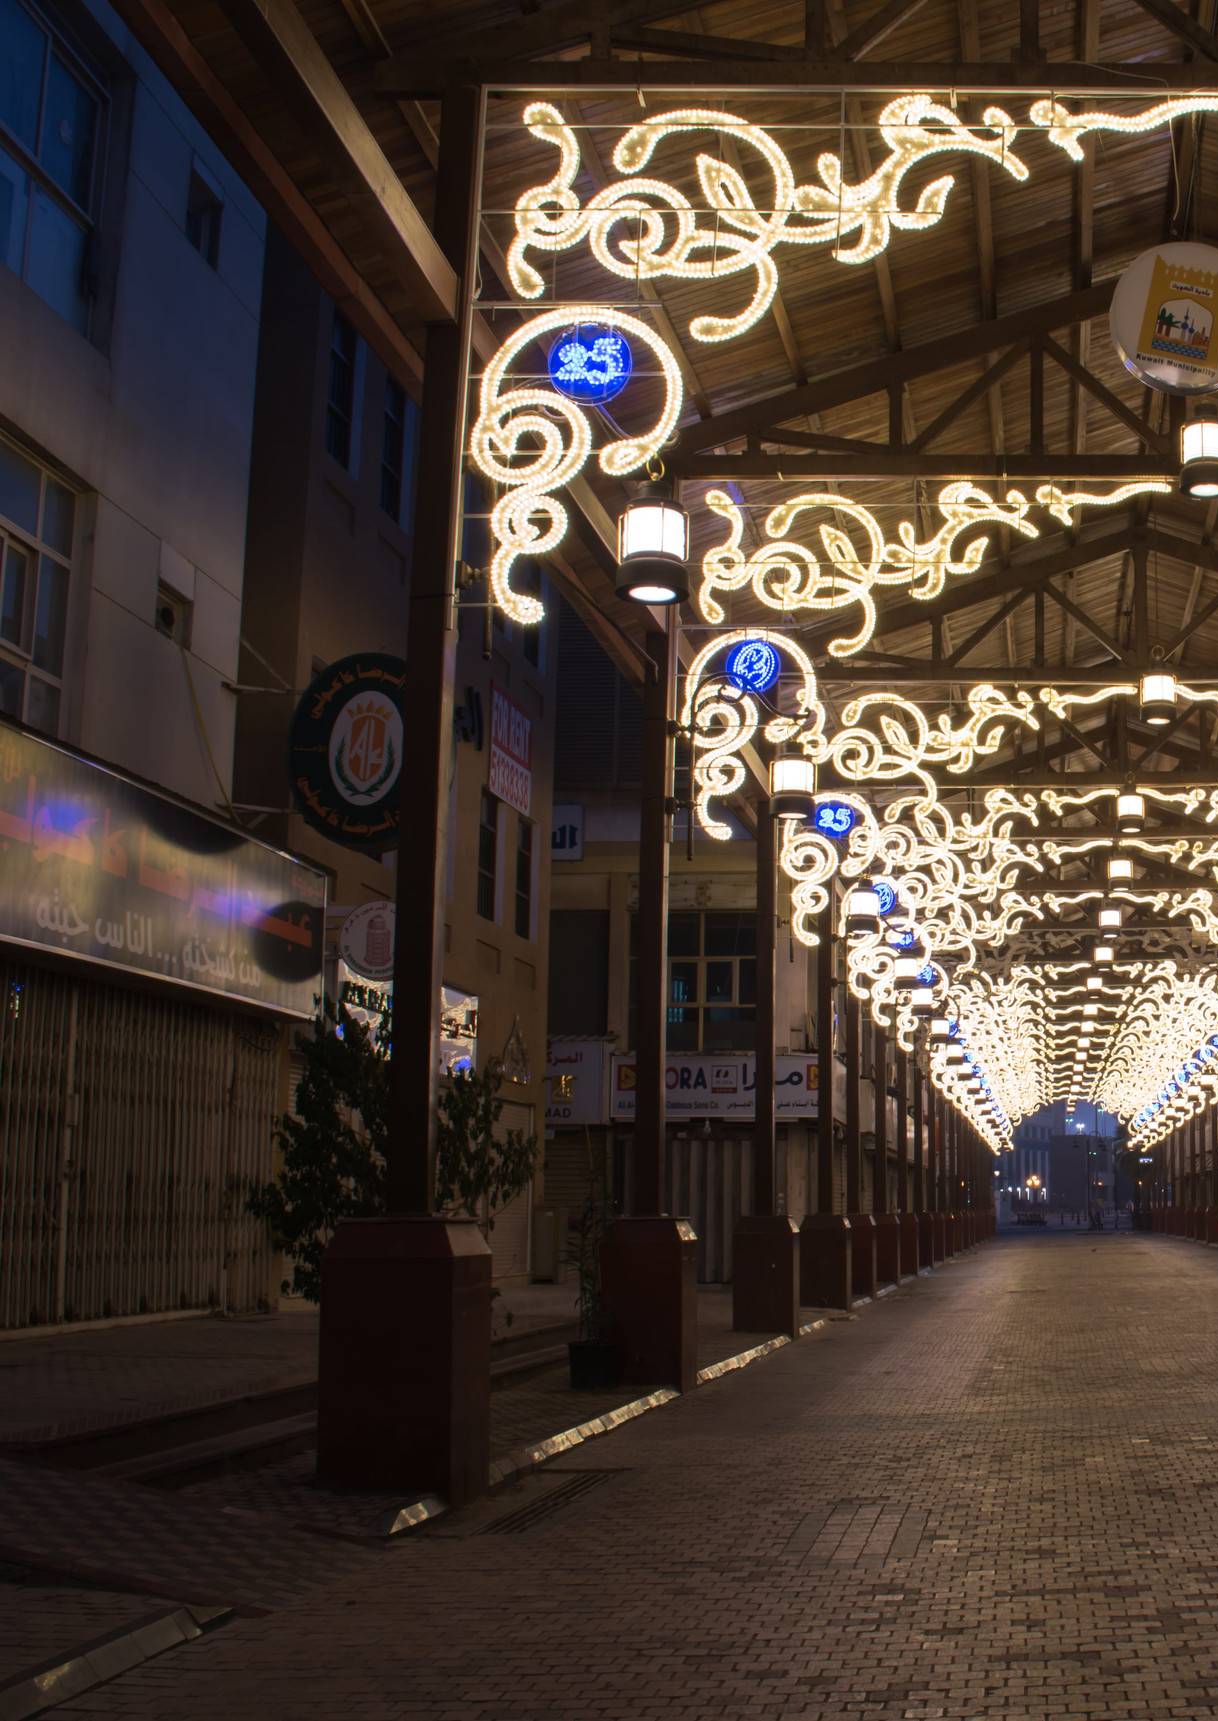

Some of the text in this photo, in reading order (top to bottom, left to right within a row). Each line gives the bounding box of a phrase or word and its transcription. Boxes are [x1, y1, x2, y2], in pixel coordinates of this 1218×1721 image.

[556, 337, 623, 385] 25
[1136, 352, 1217, 378] Kuwait Municipality
[818, 808, 851, 832] 25
